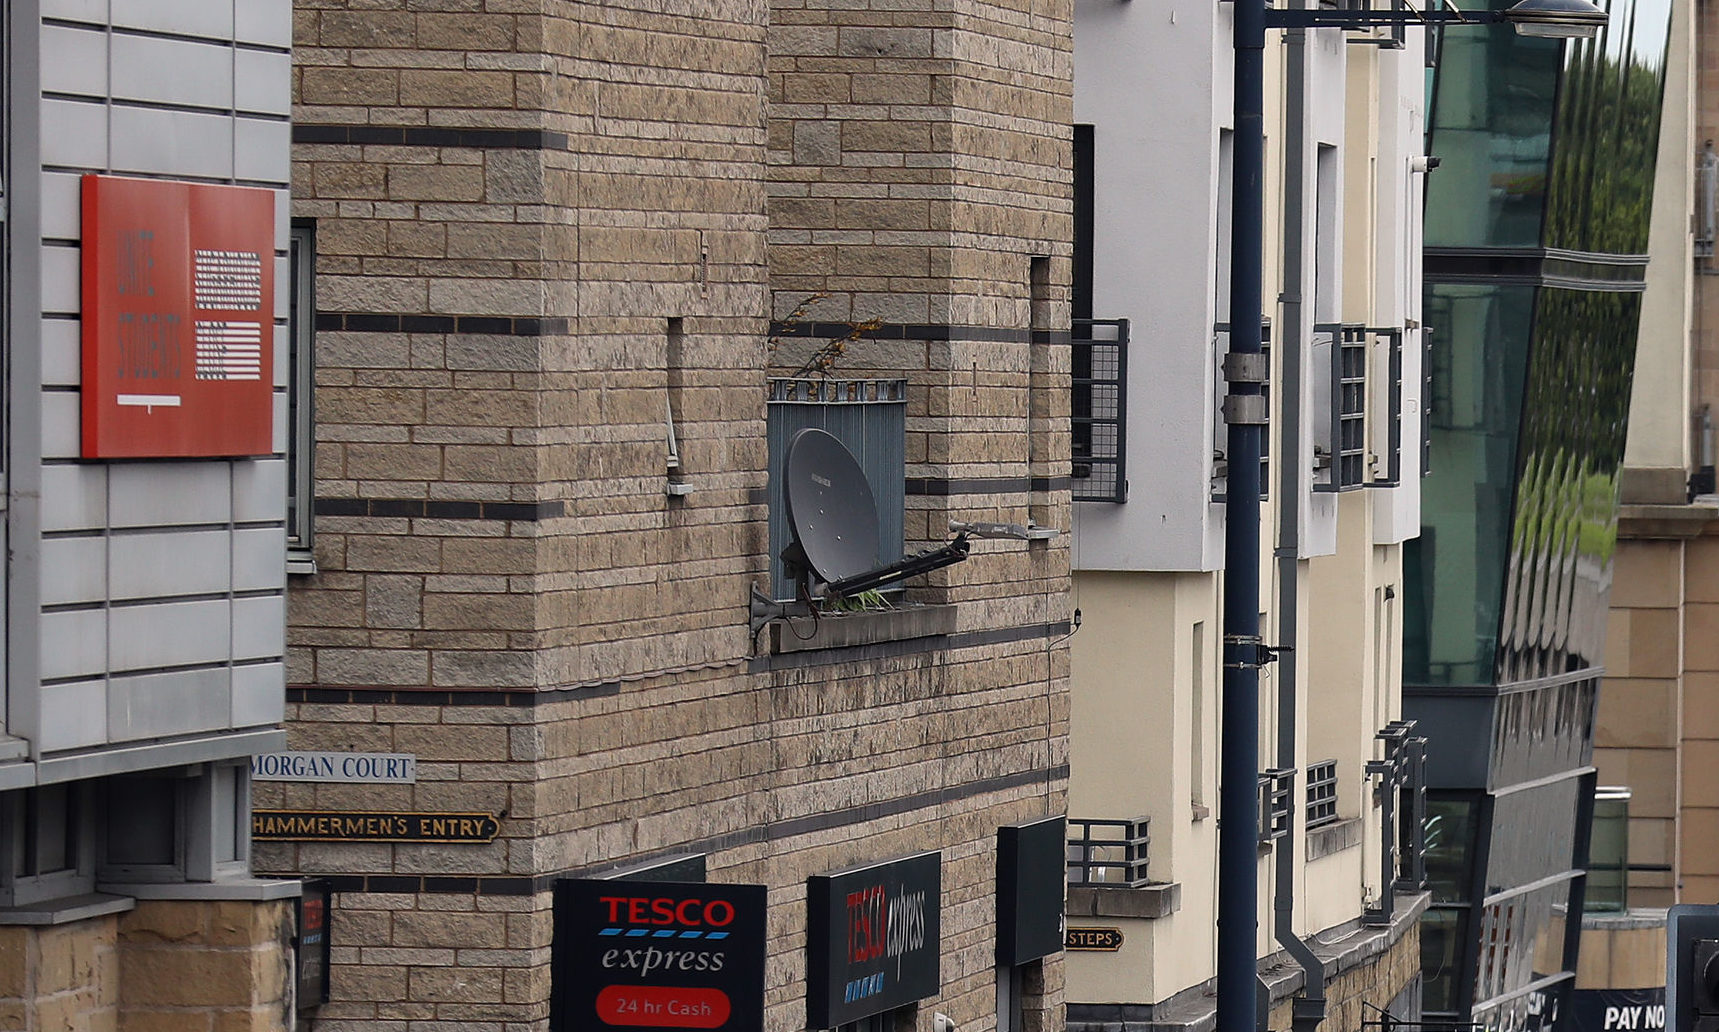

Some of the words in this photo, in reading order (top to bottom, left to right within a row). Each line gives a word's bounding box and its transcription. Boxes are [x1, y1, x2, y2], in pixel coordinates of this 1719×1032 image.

[249, 754, 335, 777] MORGAN
[342, 757, 412, 779] COURT
[252, 815, 408, 838] HAMMERMEN'S
[420, 818, 485, 837] ENTRY
[600, 896, 735, 927] TESCO
[847, 884, 886, 964] TESCO
[886, 883, 925, 982] express
[1069, 932, 1113, 945] STEPS
[602, 946, 725, 977] express
[616, 999, 638, 1013] 24
[644, 1000, 663, 1015] hr
[667, 1000, 712, 1016] Cash
[1604, 1006, 1643, 1030] PAY
